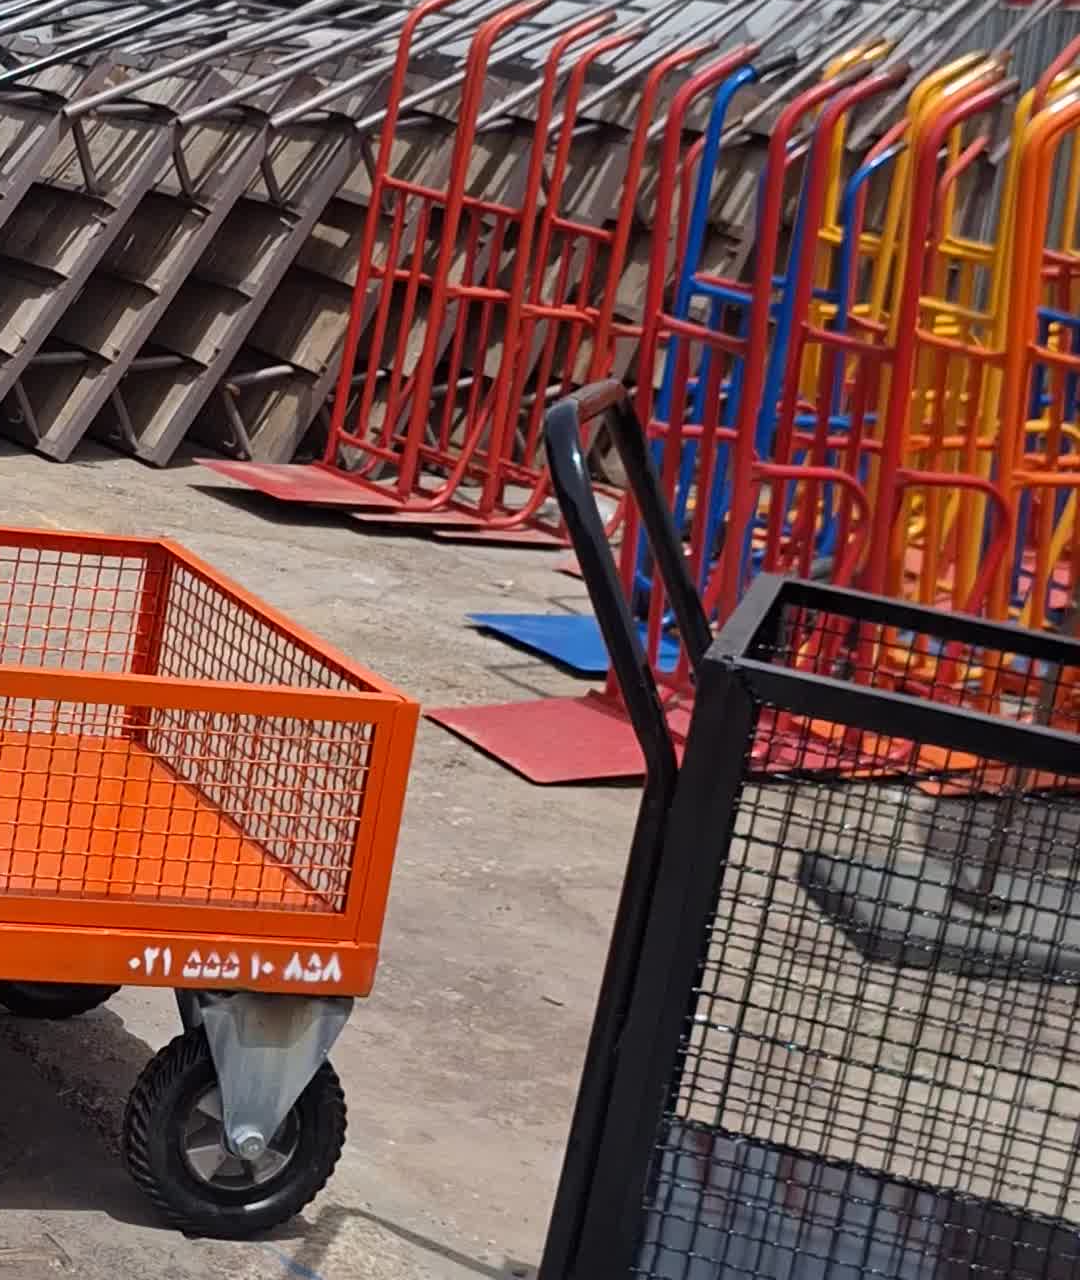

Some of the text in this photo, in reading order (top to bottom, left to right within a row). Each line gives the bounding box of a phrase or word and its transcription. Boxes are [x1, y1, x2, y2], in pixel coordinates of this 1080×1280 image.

[128, 946, 343, 984] ۰۲۱ ۵۵۵ ۱۰ ۸۵۸
